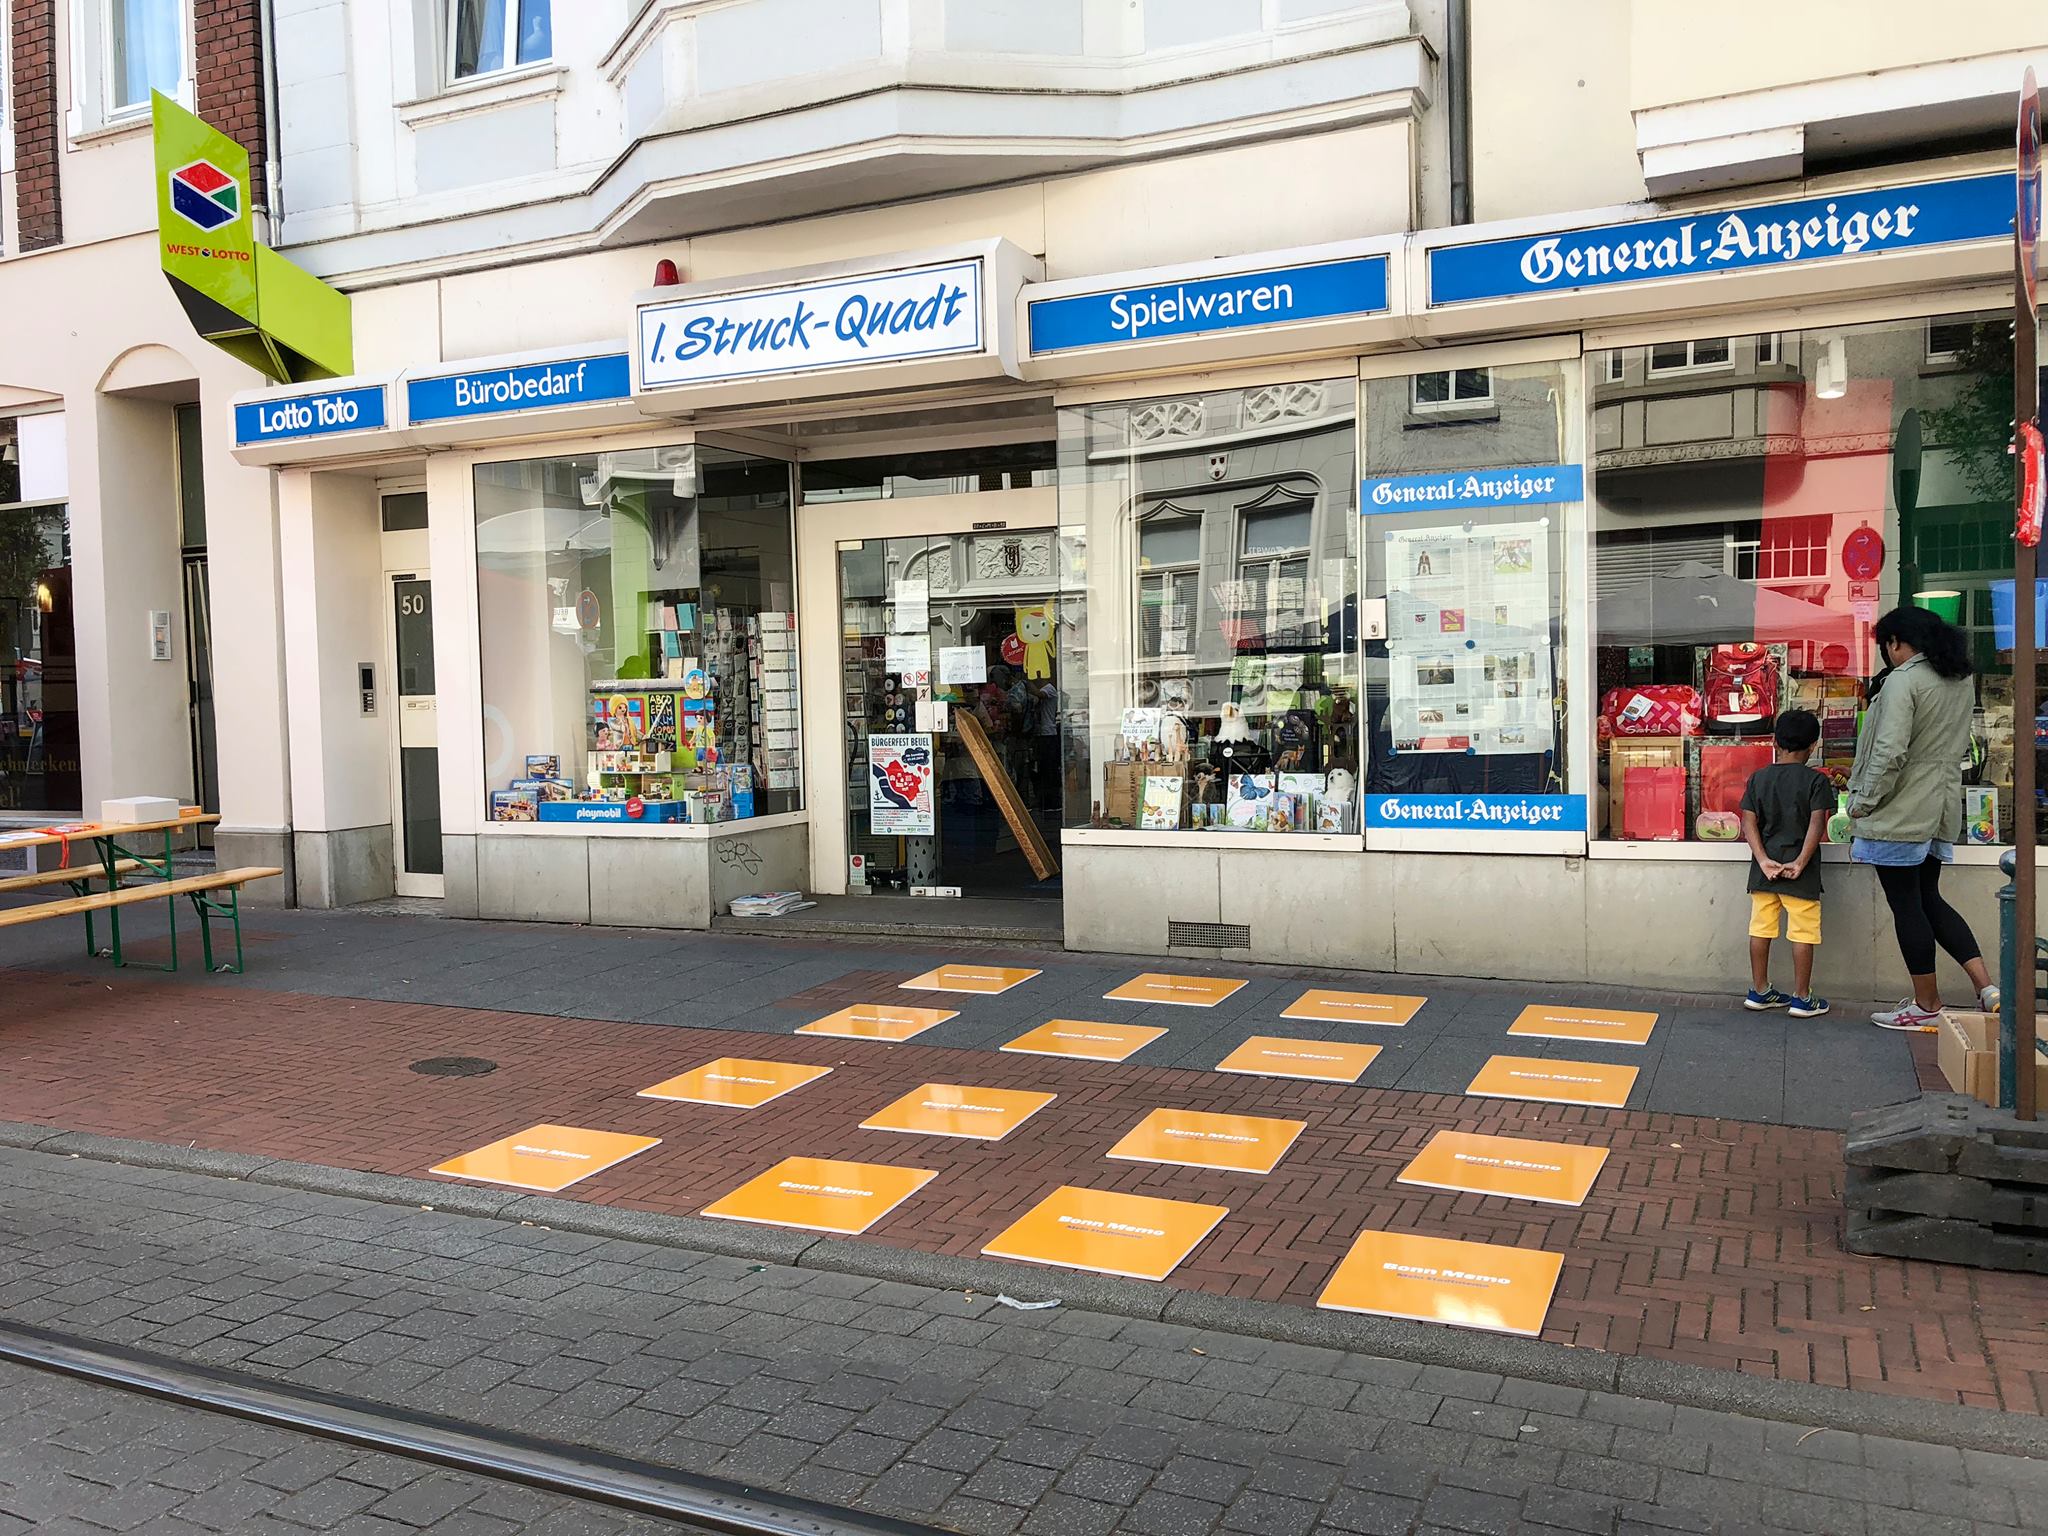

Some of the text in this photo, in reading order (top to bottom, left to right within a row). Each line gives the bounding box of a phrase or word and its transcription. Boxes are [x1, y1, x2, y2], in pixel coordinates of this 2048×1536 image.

[167, 243, 250, 261] WEST LOTTO
[1520, 203, 1920, 284] General-Anzeiger
[1110, 284, 1293, 338] Spielwaren
[675, 283, 968, 361] Struck-Quadt
[455, 363, 587, 407] Bürobedarf
[259, 399, 359, 434] Lotto Toto
[1372, 474, 1556, 505] General-Anzeiger
[402, 594, 424, 615] 50
[871, 736, 930, 746] BÜRGERFEST BEUEL
[576, 807, 622, 819] playmobil
[1551, 1074, 1602, 1082] Memo
[921, 1100, 959, 1110] Bonn
[958, 1104, 1005, 1113] Memo
[1163, 1128, 1205, 1137] Bonn
[1207, 1132, 1260, 1142] Memo
[1454, 1153, 1500, 1164] Bonn
[1503, 1159, 1562, 1171] Memo
[778, 1180, 820, 1192] Bonn
[821, 1184, 874, 1198] Memo
[1058, 1215, 1165, 1236] Bonn Memo
[1383, 1262, 1511, 1285] Bonn Memo
